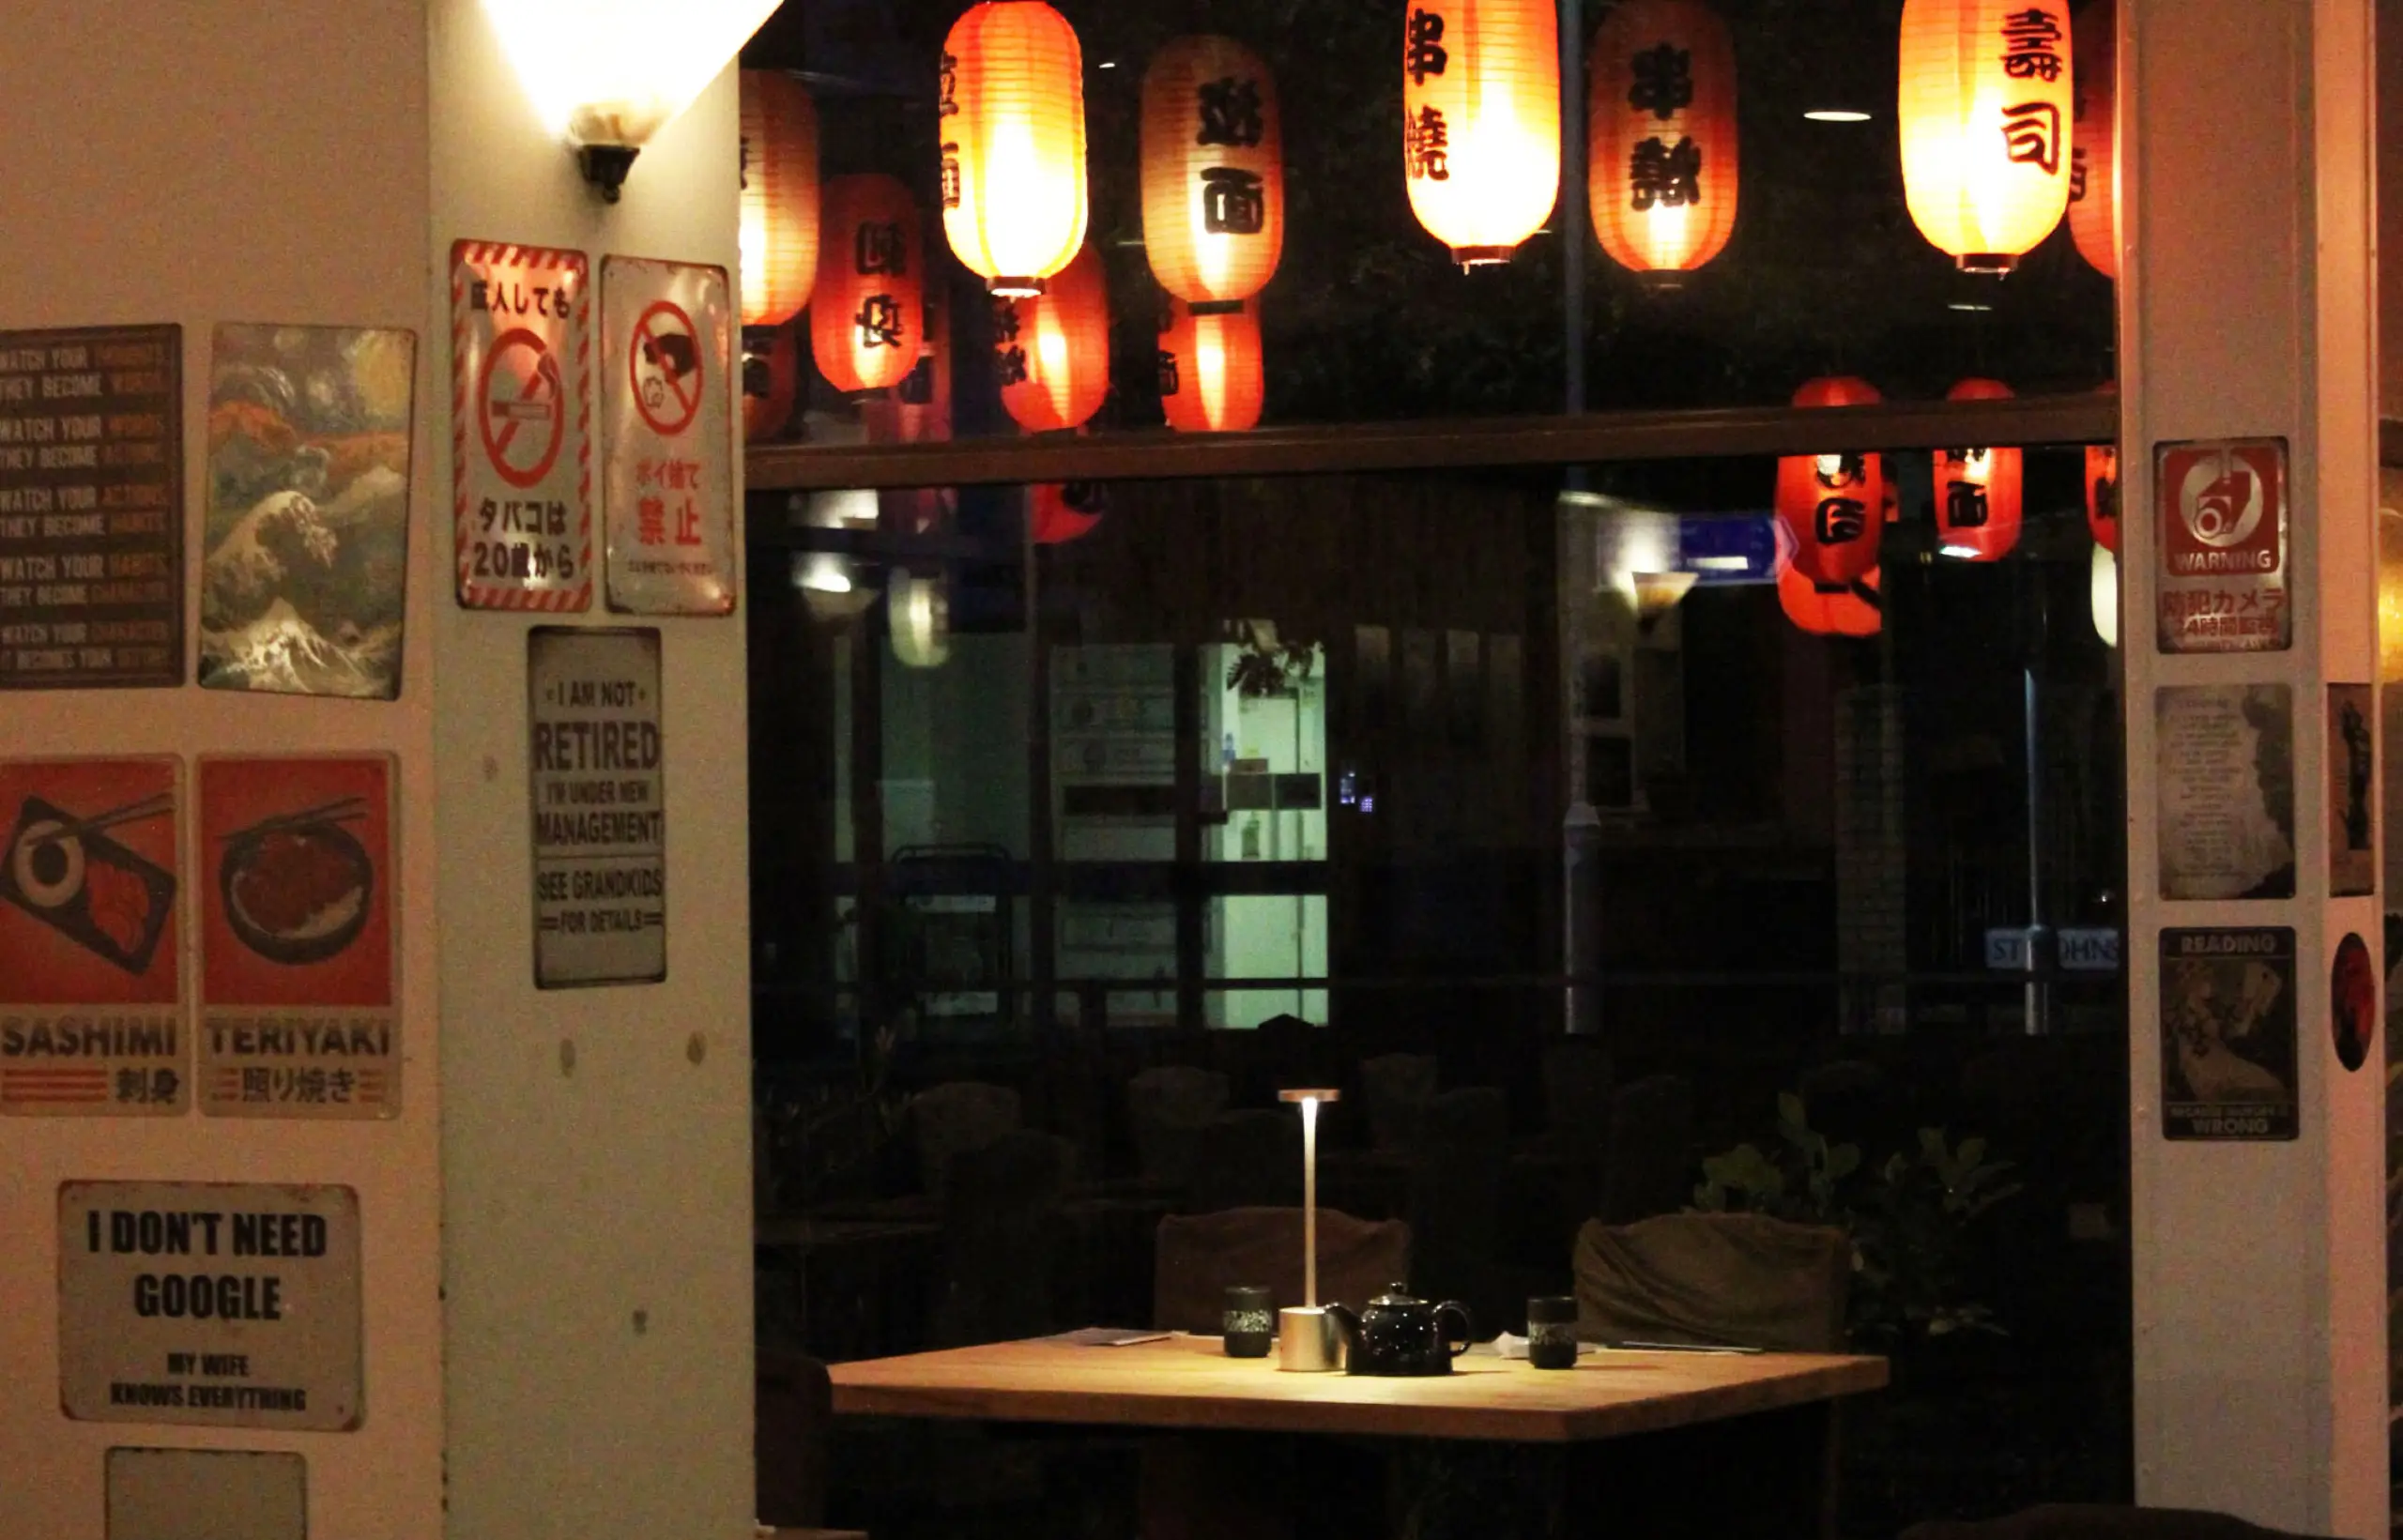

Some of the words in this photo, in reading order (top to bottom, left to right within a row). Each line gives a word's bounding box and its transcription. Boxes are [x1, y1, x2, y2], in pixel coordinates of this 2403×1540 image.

[59, 414, 102, 439] YOUR
[479, 496, 568, 536] タバコは
[638, 496, 703, 546] 禁止
[0, 555, 56, 581] WATCH
[60, 553, 105, 579] YOUR
[2173, 549, 2272, 572] WARNING
[558, 683, 563, 707] I
[569, 682, 595, 708] AM
[602, 681, 635, 708] NOT
[533, 721, 658, 771] RETIRED
[571, 780, 614, 805] UNDER
[619, 780, 648, 804] NEW
[537, 808, 661, 846] MANAGEMENT
[537, 871, 567, 902] SEE
[572, 868, 663, 902] GRANDKIDS
[559, 909, 586, 935] FOR
[589, 908, 642, 934] DETAILS
[1994, 938, 2021, 960] ST
[2063, 937, 2119, 960] HNS
[2181, 932, 2277, 954] READING
[1, 1016, 177, 1059] SASHIMI
[206, 1017, 390, 1057] TERIYAKI
[115, 1067, 180, 1105] 刺身
[241, 1066, 356, 1105] 照り焼き
[2192, 1118, 2269, 1136] WRONG
[88, 1210, 100, 1253] I
[111, 1210, 224, 1256] DON'T
[232, 1213, 327, 1258] NEED
[134, 1273, 282, 1321] GOOGLE
[167, 1352, 199, 1377] MY
[202, 1353, 250, 1378] WIFE
[111, 1381, 185, 1406] KNOWS
[188, 1383, 307, 1411] EVERYTHING
